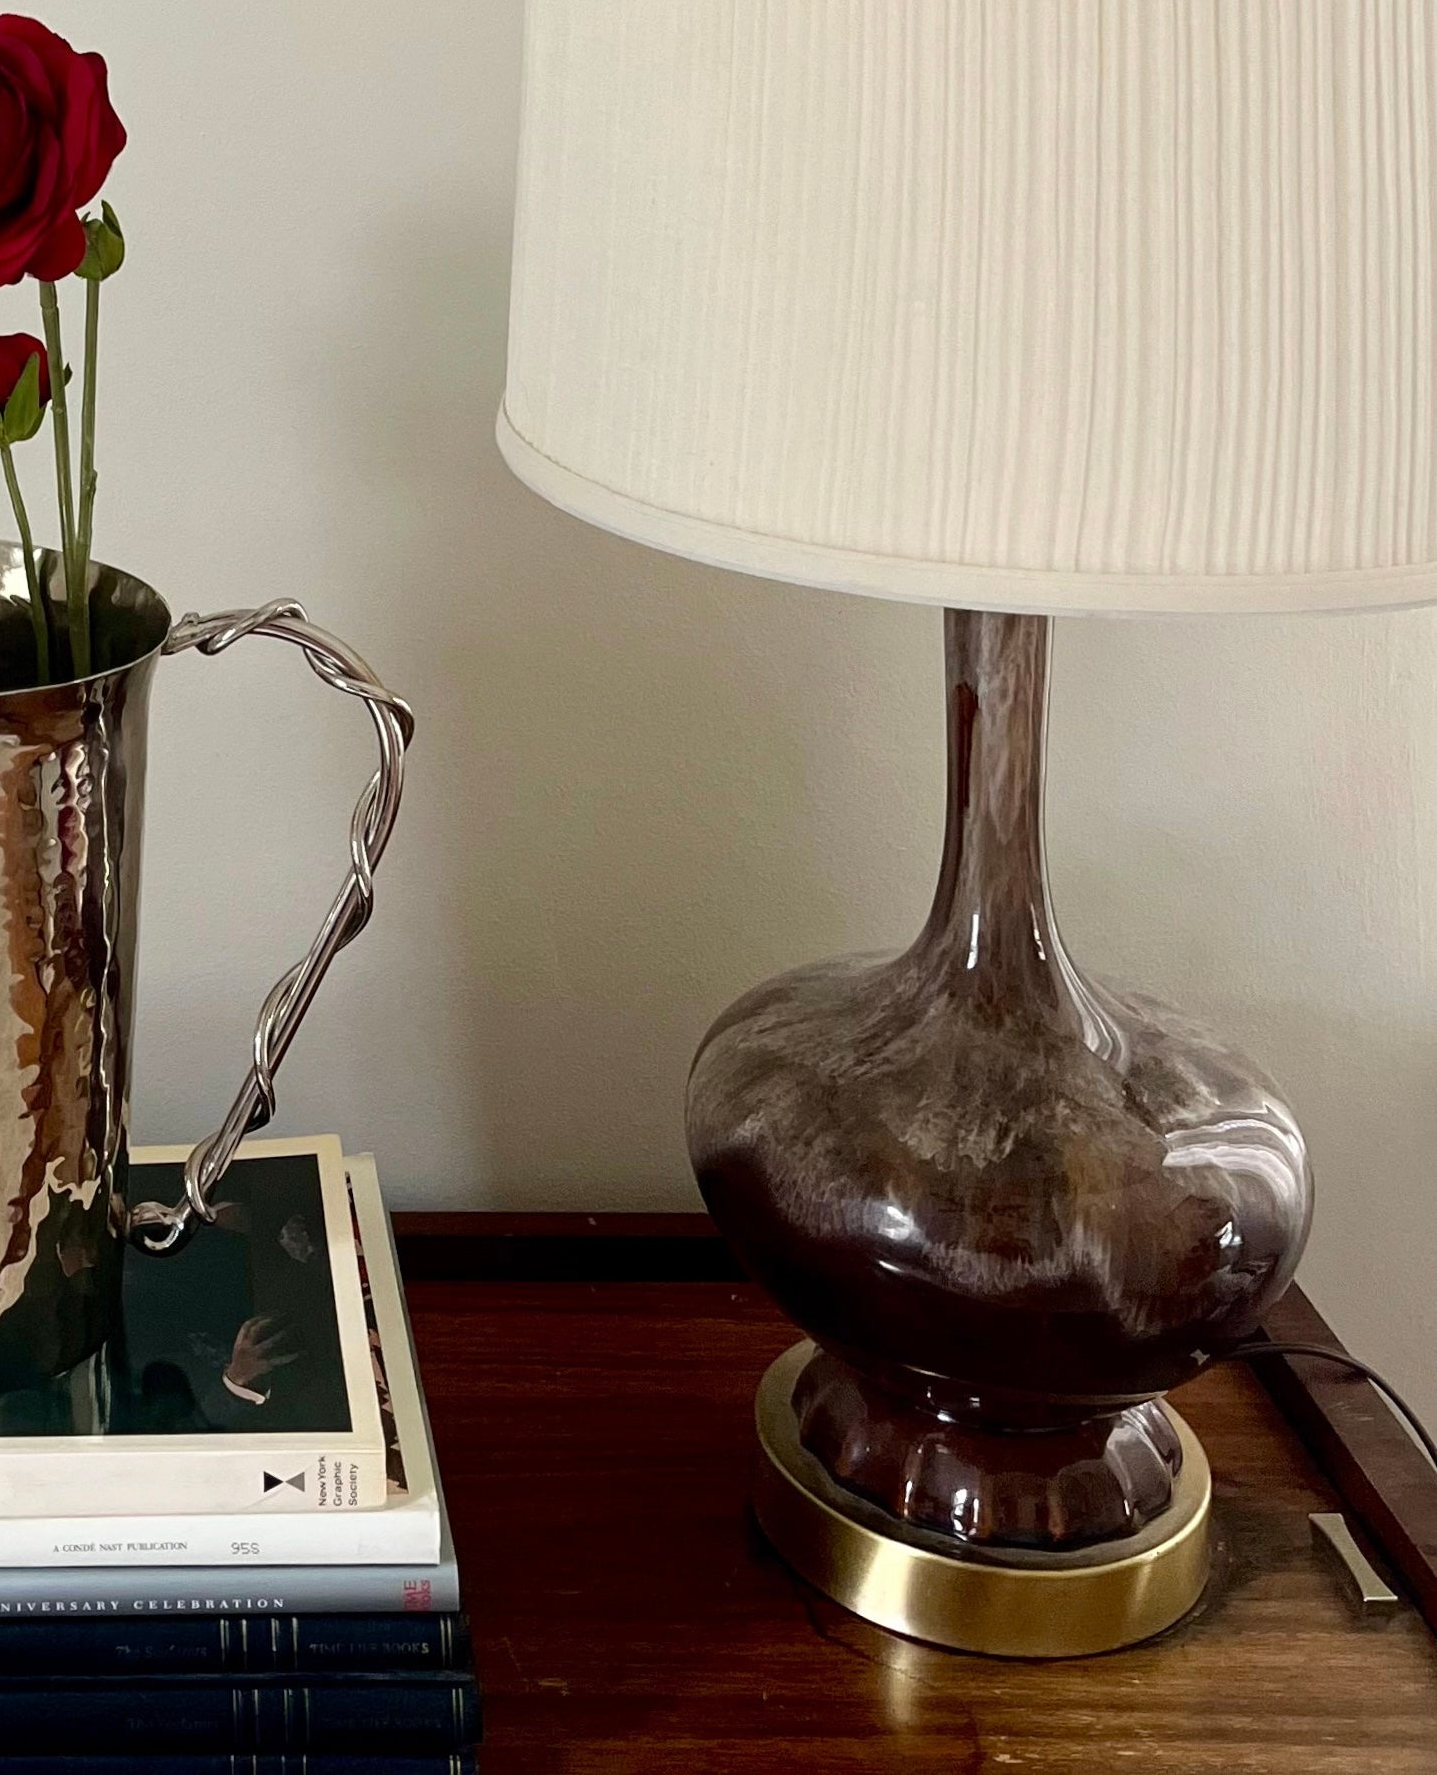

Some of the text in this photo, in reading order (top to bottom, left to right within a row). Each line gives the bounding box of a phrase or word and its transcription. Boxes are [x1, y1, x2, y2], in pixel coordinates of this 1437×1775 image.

[317, 1456, 327, 1506] New York
[332, 1461, 343, 1507] Graphic
[348, 1463, 359, 1506] Society
[53, 1545, 60, 1553] A
[99, 1543, 123, 1552] NAST
[126, 1541, 188, 1552] PUBLICATION
[133, 1598, 285, 1611] CELEBRATION
